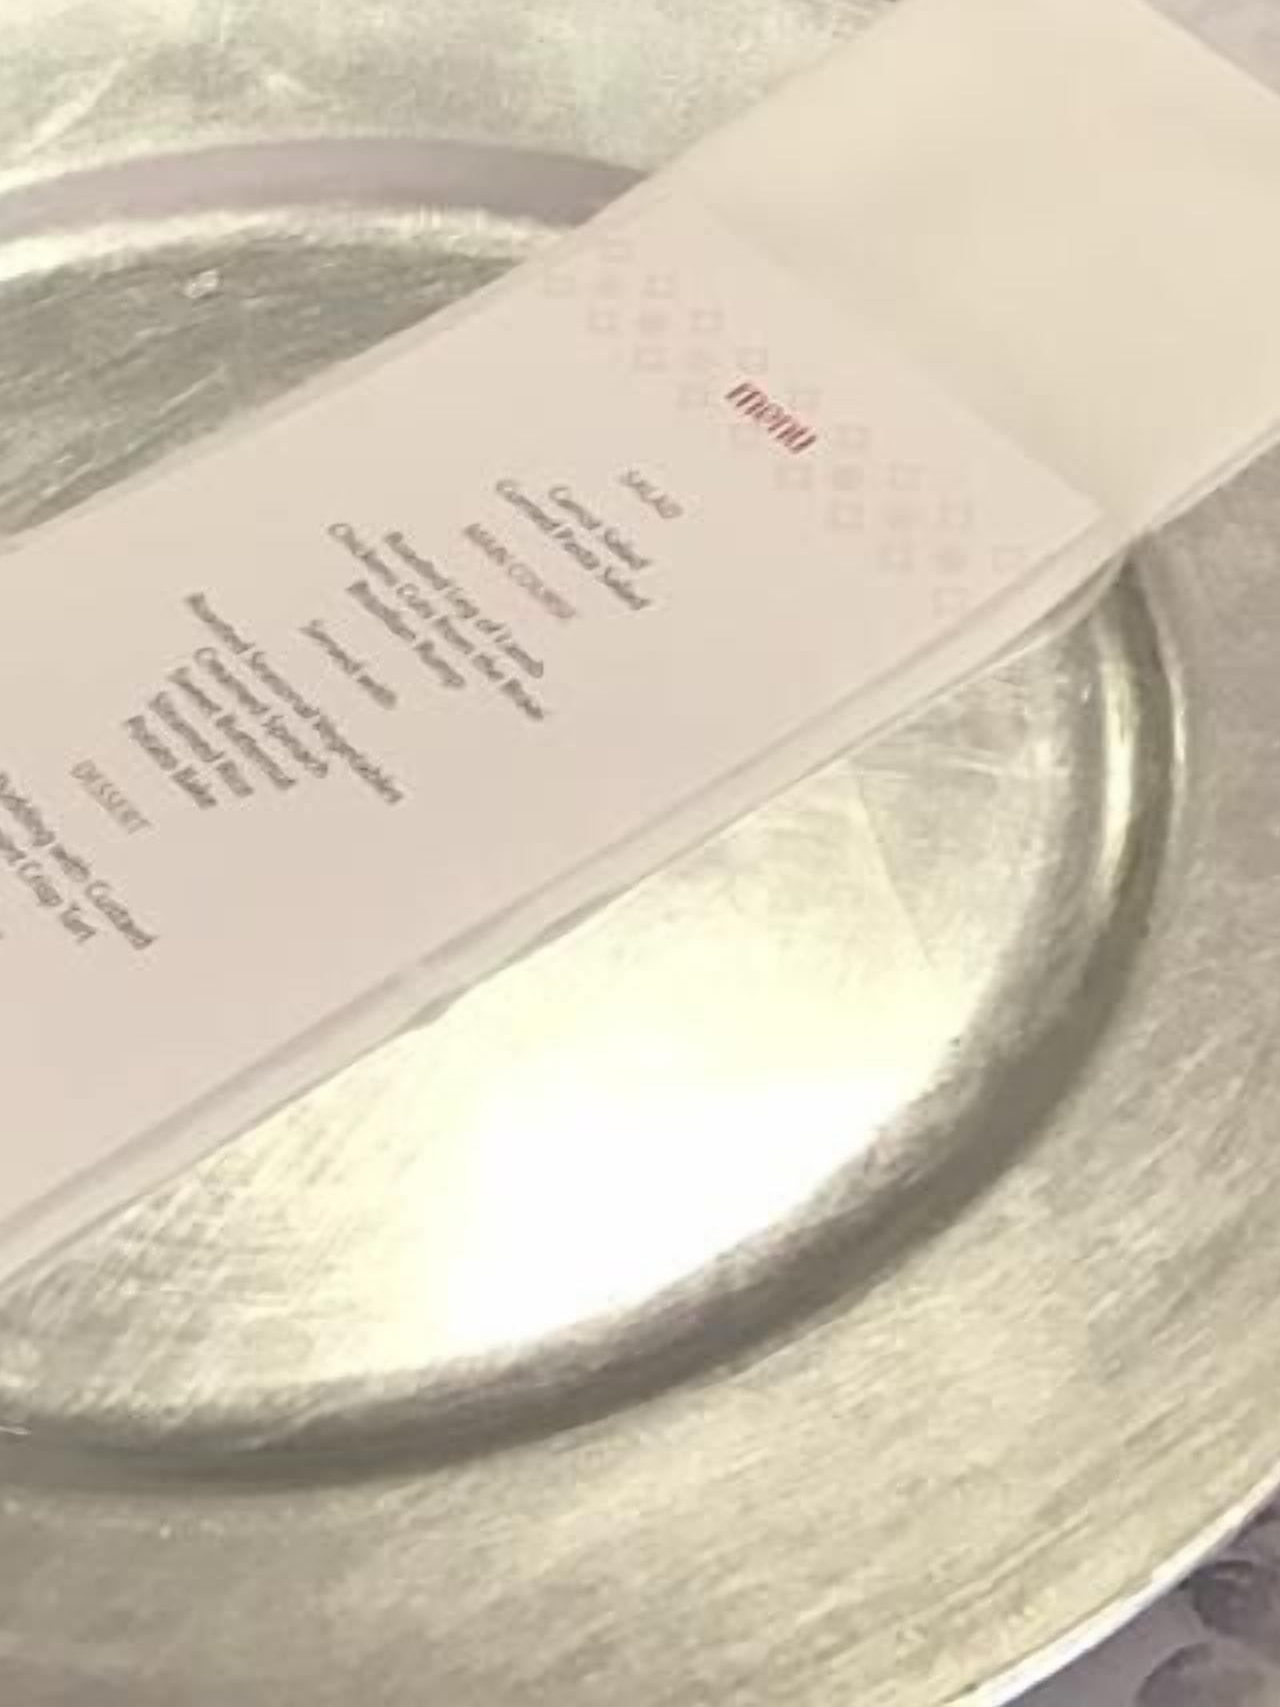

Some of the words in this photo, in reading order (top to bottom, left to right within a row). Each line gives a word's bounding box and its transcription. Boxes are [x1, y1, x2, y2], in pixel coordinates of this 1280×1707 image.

[726, 382, 817, 454] menu
[463, 524, 510, 567] MAIN
[554, 527, 600, 570] Pasta
[601, 566, 651, 610] Salad
[603, 527, 652, 570] Salad
[434, 616, 475, 654] from
[472, 652, 504, 681] the
[447, 588, 479, 619] Leg
[476, 617, 504, 636] of
[494, 631, 544, 678] Lamb
[185, 593, 254, 655] Roasted
[246, 650, 319, 718] Seasonal
[313, 714, 404, 805] Vegetables
[194, 647, 271, 716] Creamed
[263, 714, 329, 778] Spinach
[357, 673, 397, 710] with
[126, 714, 178, 771] Potato
[171, 765, 217, 809] Bake
[149, 690, 223, 763] Steamed
[217, 759, 254, 798] Rice
[215, 713, 296, 790] Butternut
[70, 759, 152, 834] DESSERT
[17, 859, 64, 909] Crisp
[58, 901, 98, 944] Tart
[49, 843, 90, 883] with
[85, 879, 158, 951] Custard
